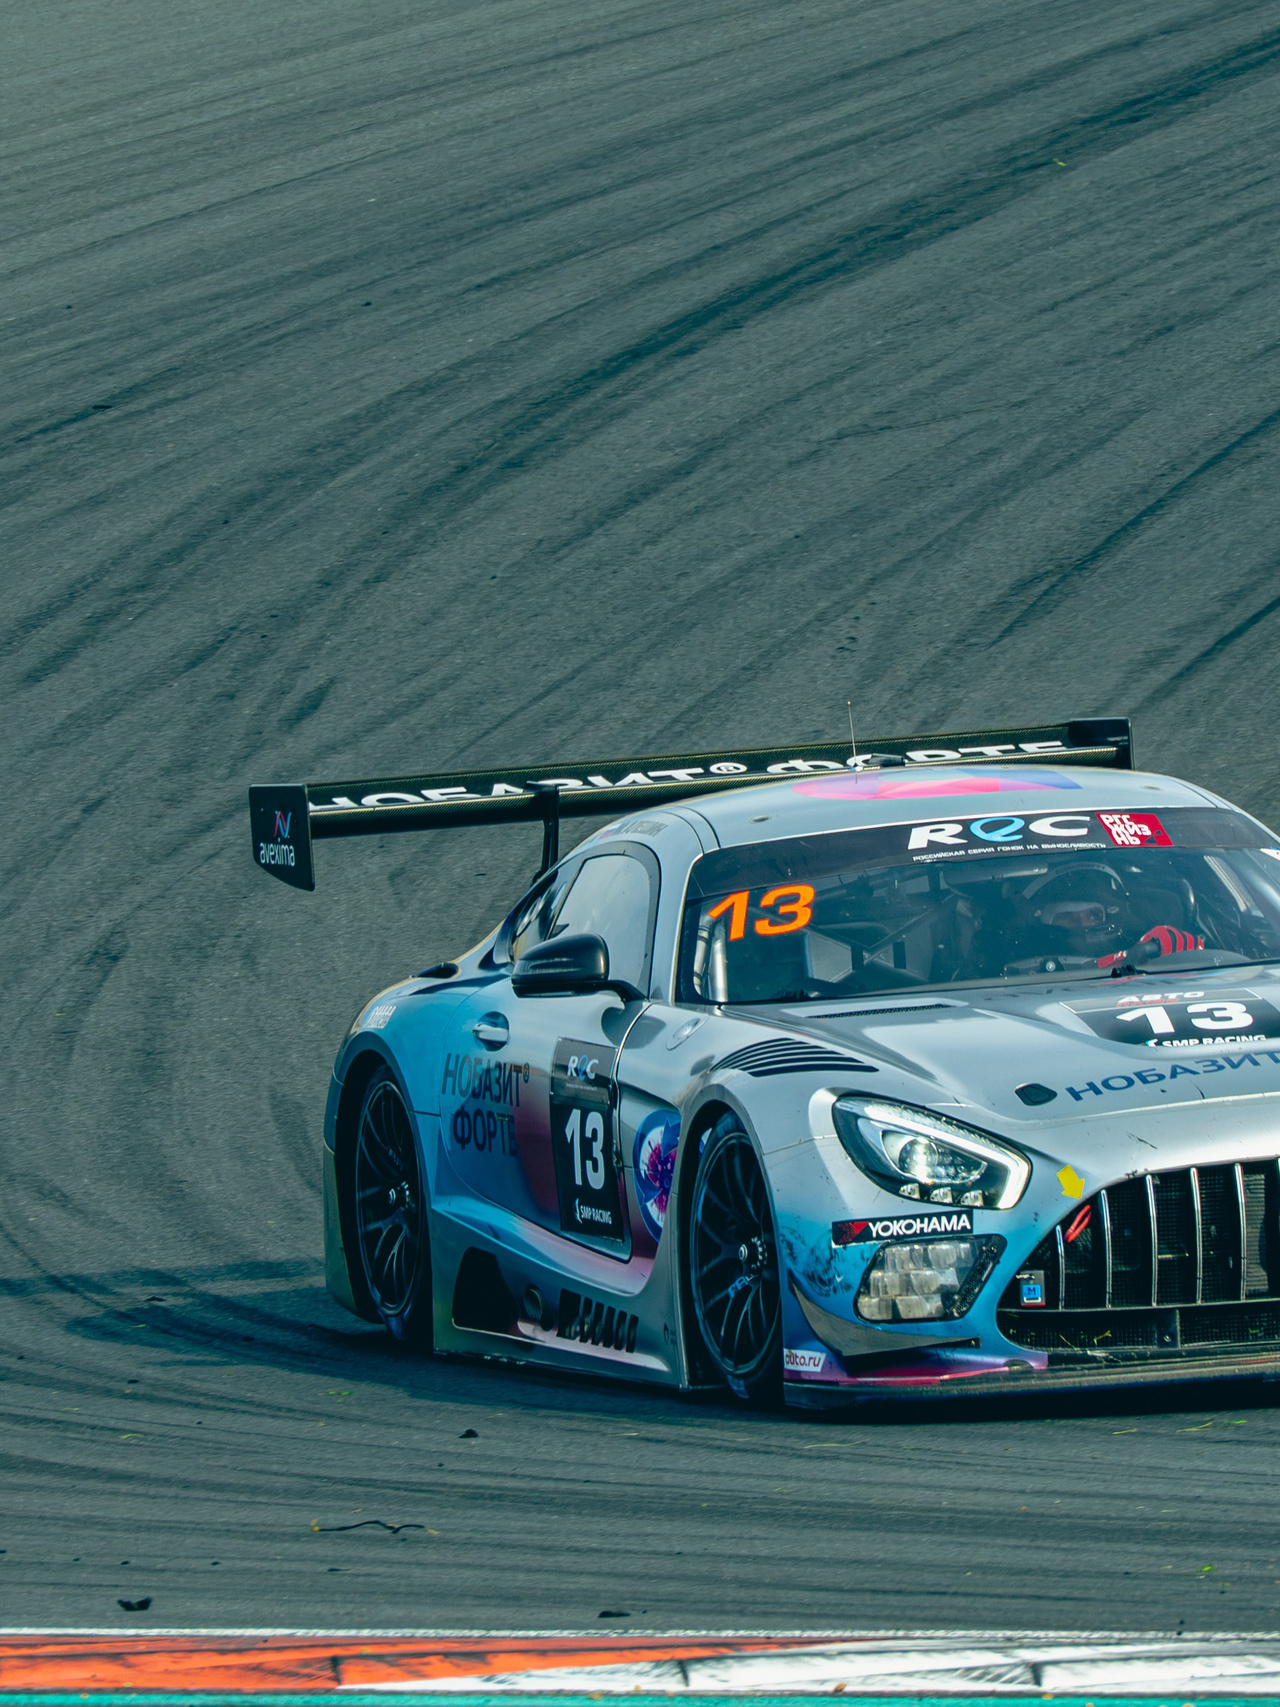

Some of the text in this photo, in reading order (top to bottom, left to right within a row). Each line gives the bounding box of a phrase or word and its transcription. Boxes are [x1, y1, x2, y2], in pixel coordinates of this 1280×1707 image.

[1099, 814, 1131, 824] РГС
[259, 838, 295, 867] avexima
[912, 850, 965, 862] РОССИЙСКАЯ
[967, 847, 995, 855] СЕРИЯ
[707, 884, 815, 942] 13
[1116, 1001, 1253, 1034] 13
[1161, 1034, 1267, 1047] SMP RACING
[453, 1105, 518, 1157] ФОРТЕ
[564, 1108, 606, 1190] 13
[868, 1214, 971, 1238] YOKOHAMA
